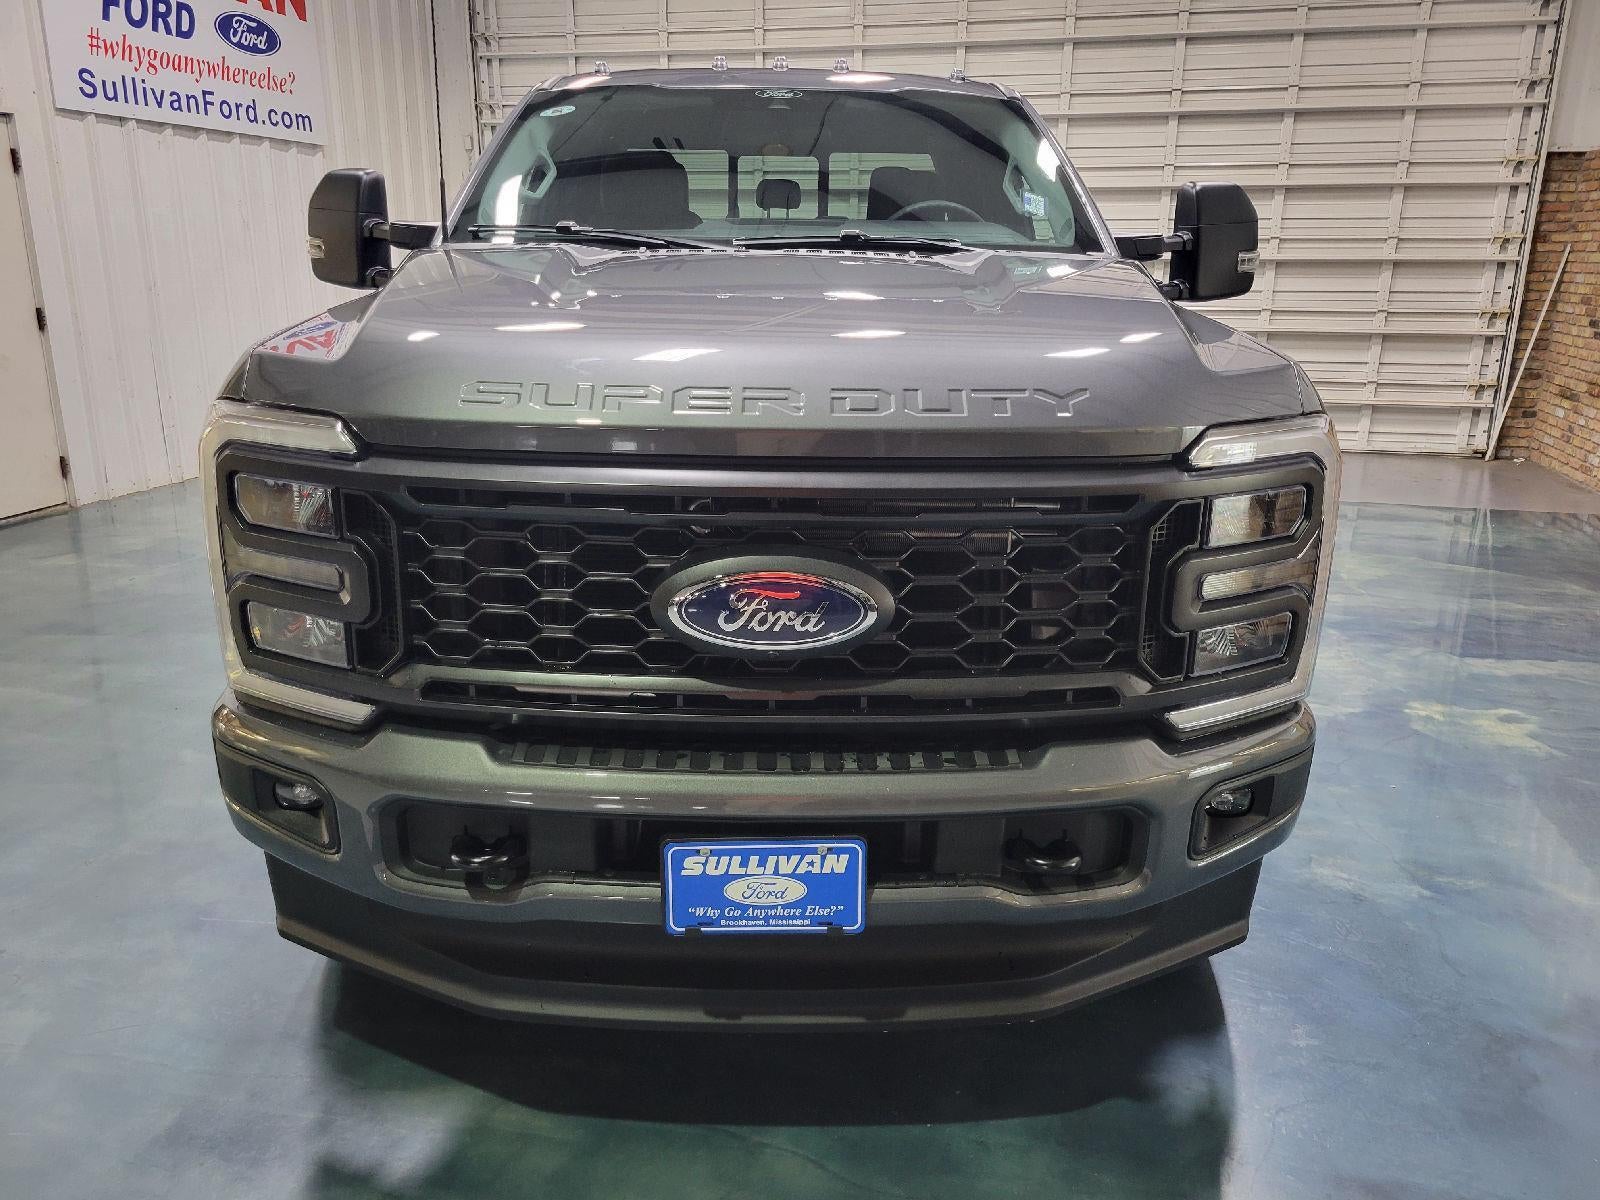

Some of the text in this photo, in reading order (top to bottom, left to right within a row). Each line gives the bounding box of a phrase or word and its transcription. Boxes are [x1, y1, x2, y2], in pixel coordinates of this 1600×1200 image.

[101, 0, 196, 40] FORD
[229, 16, 268, 50] Ford
[86, 26, 297, 95] #whygoanywhereelse?
[77, 67, 313, 132] SullivanFord.com
[458, 380, 1091, 418] SUPER DUTY
[717, 588, 829, 632] Ford
[681, 854, 850, 876] SULLIVAN
[741, 881, 789, 900] Ford
[725, 907, 741, 917] Go
[744, 906, 801, 917] Anywhere
